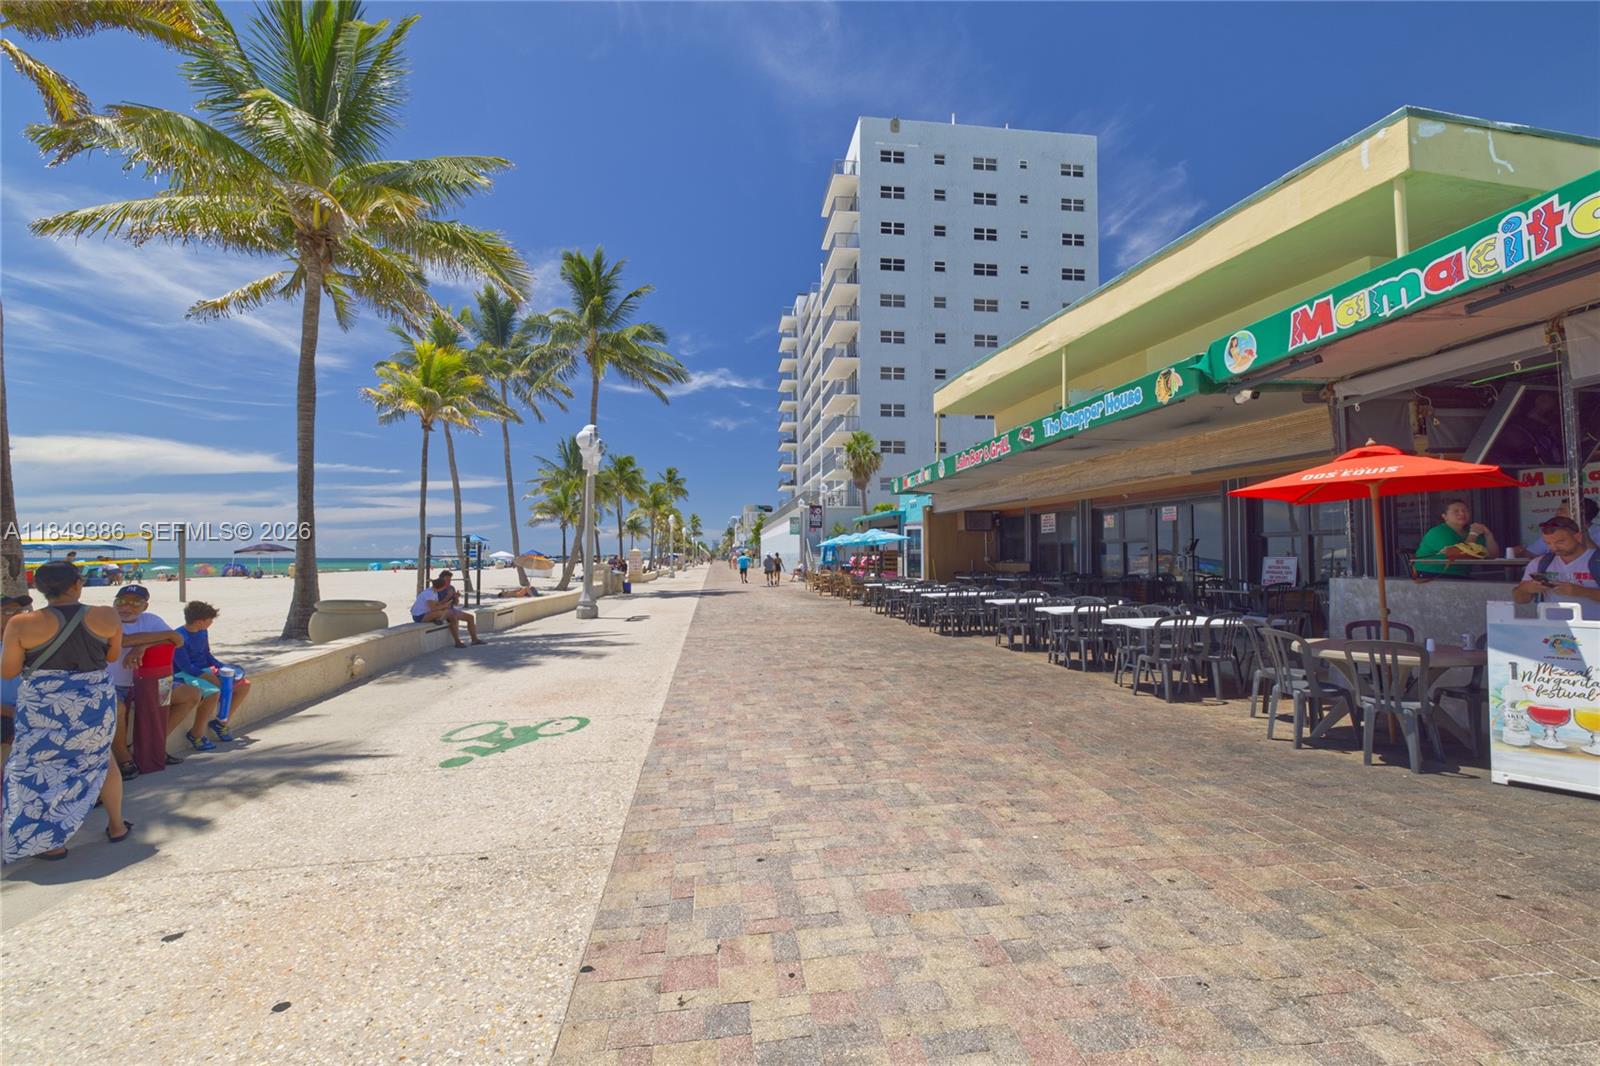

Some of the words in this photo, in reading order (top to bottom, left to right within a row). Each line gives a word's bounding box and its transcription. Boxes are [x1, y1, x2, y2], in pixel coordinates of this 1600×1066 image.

[1042, 417, 1061, 437] The
[1060, 401, 1104, 430] Snapper
[1104, 387, 1143, 416] House
[969, 448, 984, 467] Bar
[1302, 471, 1338, 480] DOS
[1536, 488, 1569, 498] LATIN
[1536, 662, 1593, 678] Mezcal
